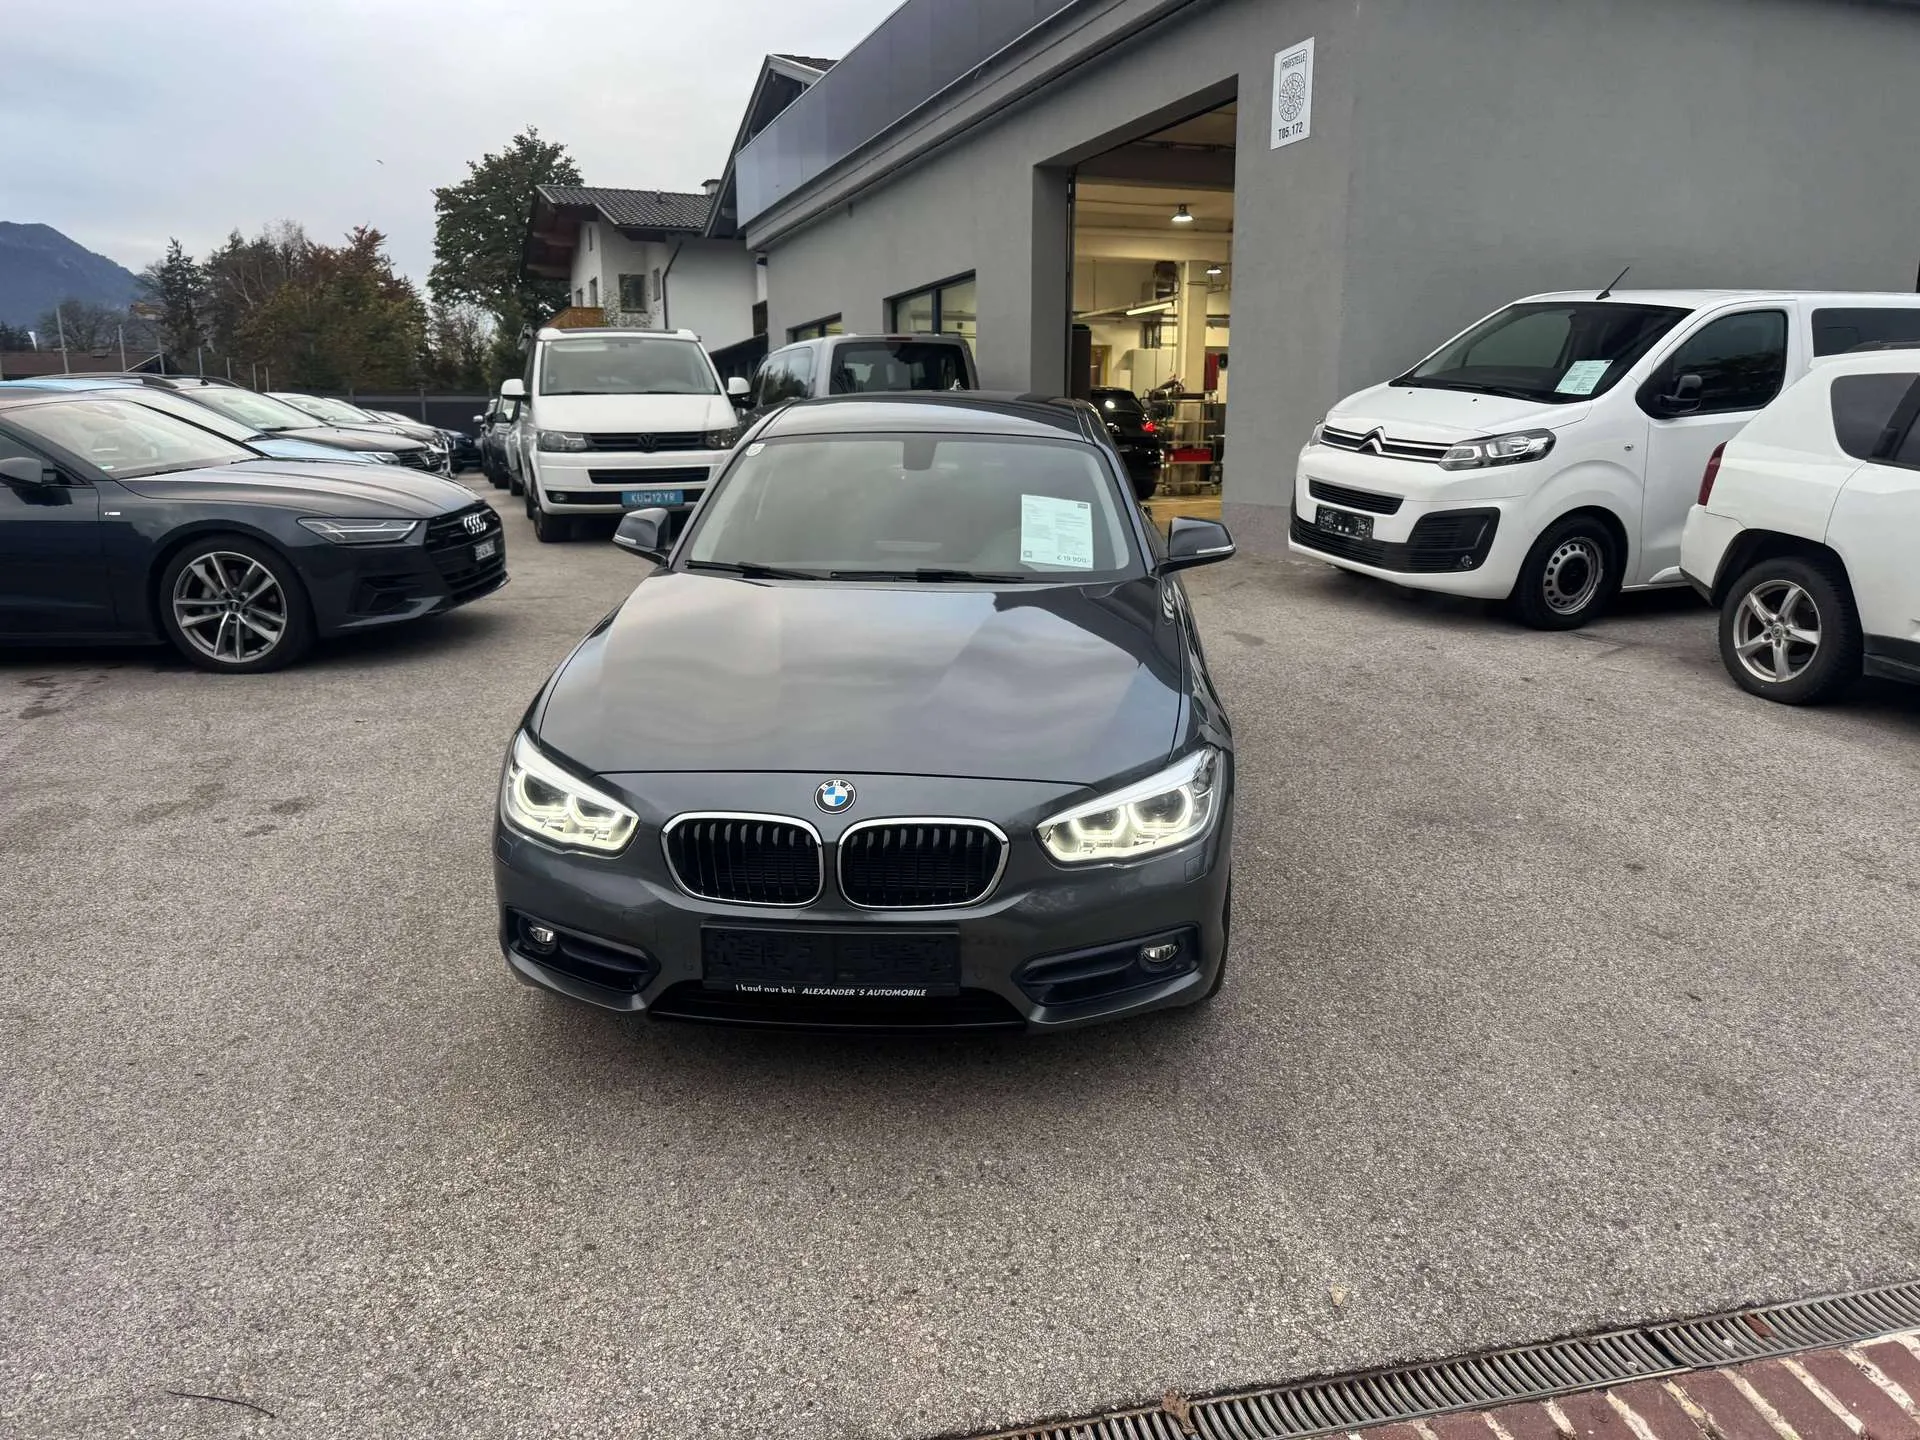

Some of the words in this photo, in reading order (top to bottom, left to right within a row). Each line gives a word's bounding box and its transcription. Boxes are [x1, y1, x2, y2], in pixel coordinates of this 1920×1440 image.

[1278, 121, 1303, 140] T05.172
[820, 779, 853, 791] BMW
[741, 984, 762, 992] kauf
[781, 985, 796, 994] bei
[866, 988, 927, 997] AUTOMOBILE
